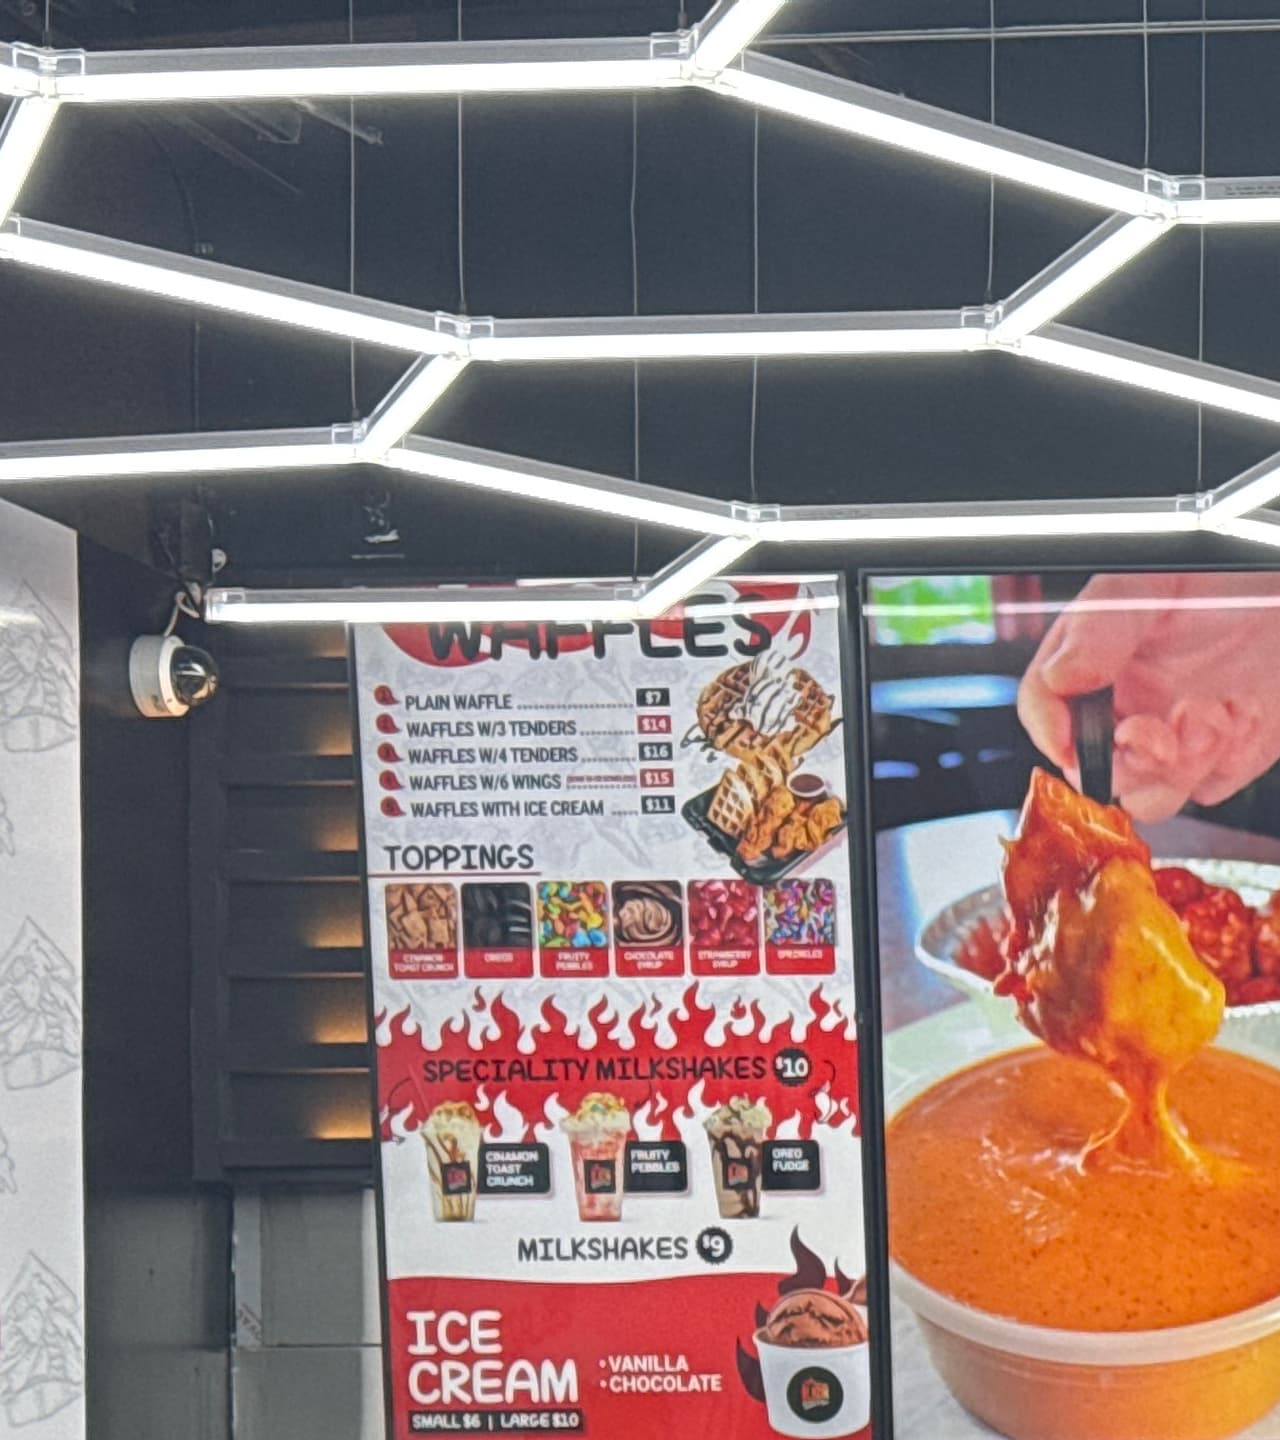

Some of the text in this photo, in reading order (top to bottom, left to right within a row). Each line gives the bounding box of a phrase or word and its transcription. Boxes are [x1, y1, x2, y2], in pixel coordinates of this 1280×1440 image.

[405, 693, 512, 711] PLAIN WAFFLE
[407, 719, 668, 737] WAFFLES W/3 TENDERS $14
[409, 776, 477, 791] WAFFLES
[480, 775, 509, 791] W/6
[511, 774, 561, 790] WINGS
[411, 800, 604, 818] WAFFLES WITH ICE CREAM
[383, 845, 535, 871] TOPPINGS
[423, 1057, 810, 1083] SPECIALITY MILKSHAKES $10
[517, 1237, 725, 1262] MILKSHAKES $9
[406, 1310, 502, 1355] ICE
[608, 1355, 689, 1373] VANILLA
[408, 1359, 579, 1406] CREAM
[608, 1374, 722, 1393] CHOCOLATE
[412, 1414, 461, 1430] SMALL
[500, 1413, 551, 1429] LARGE
